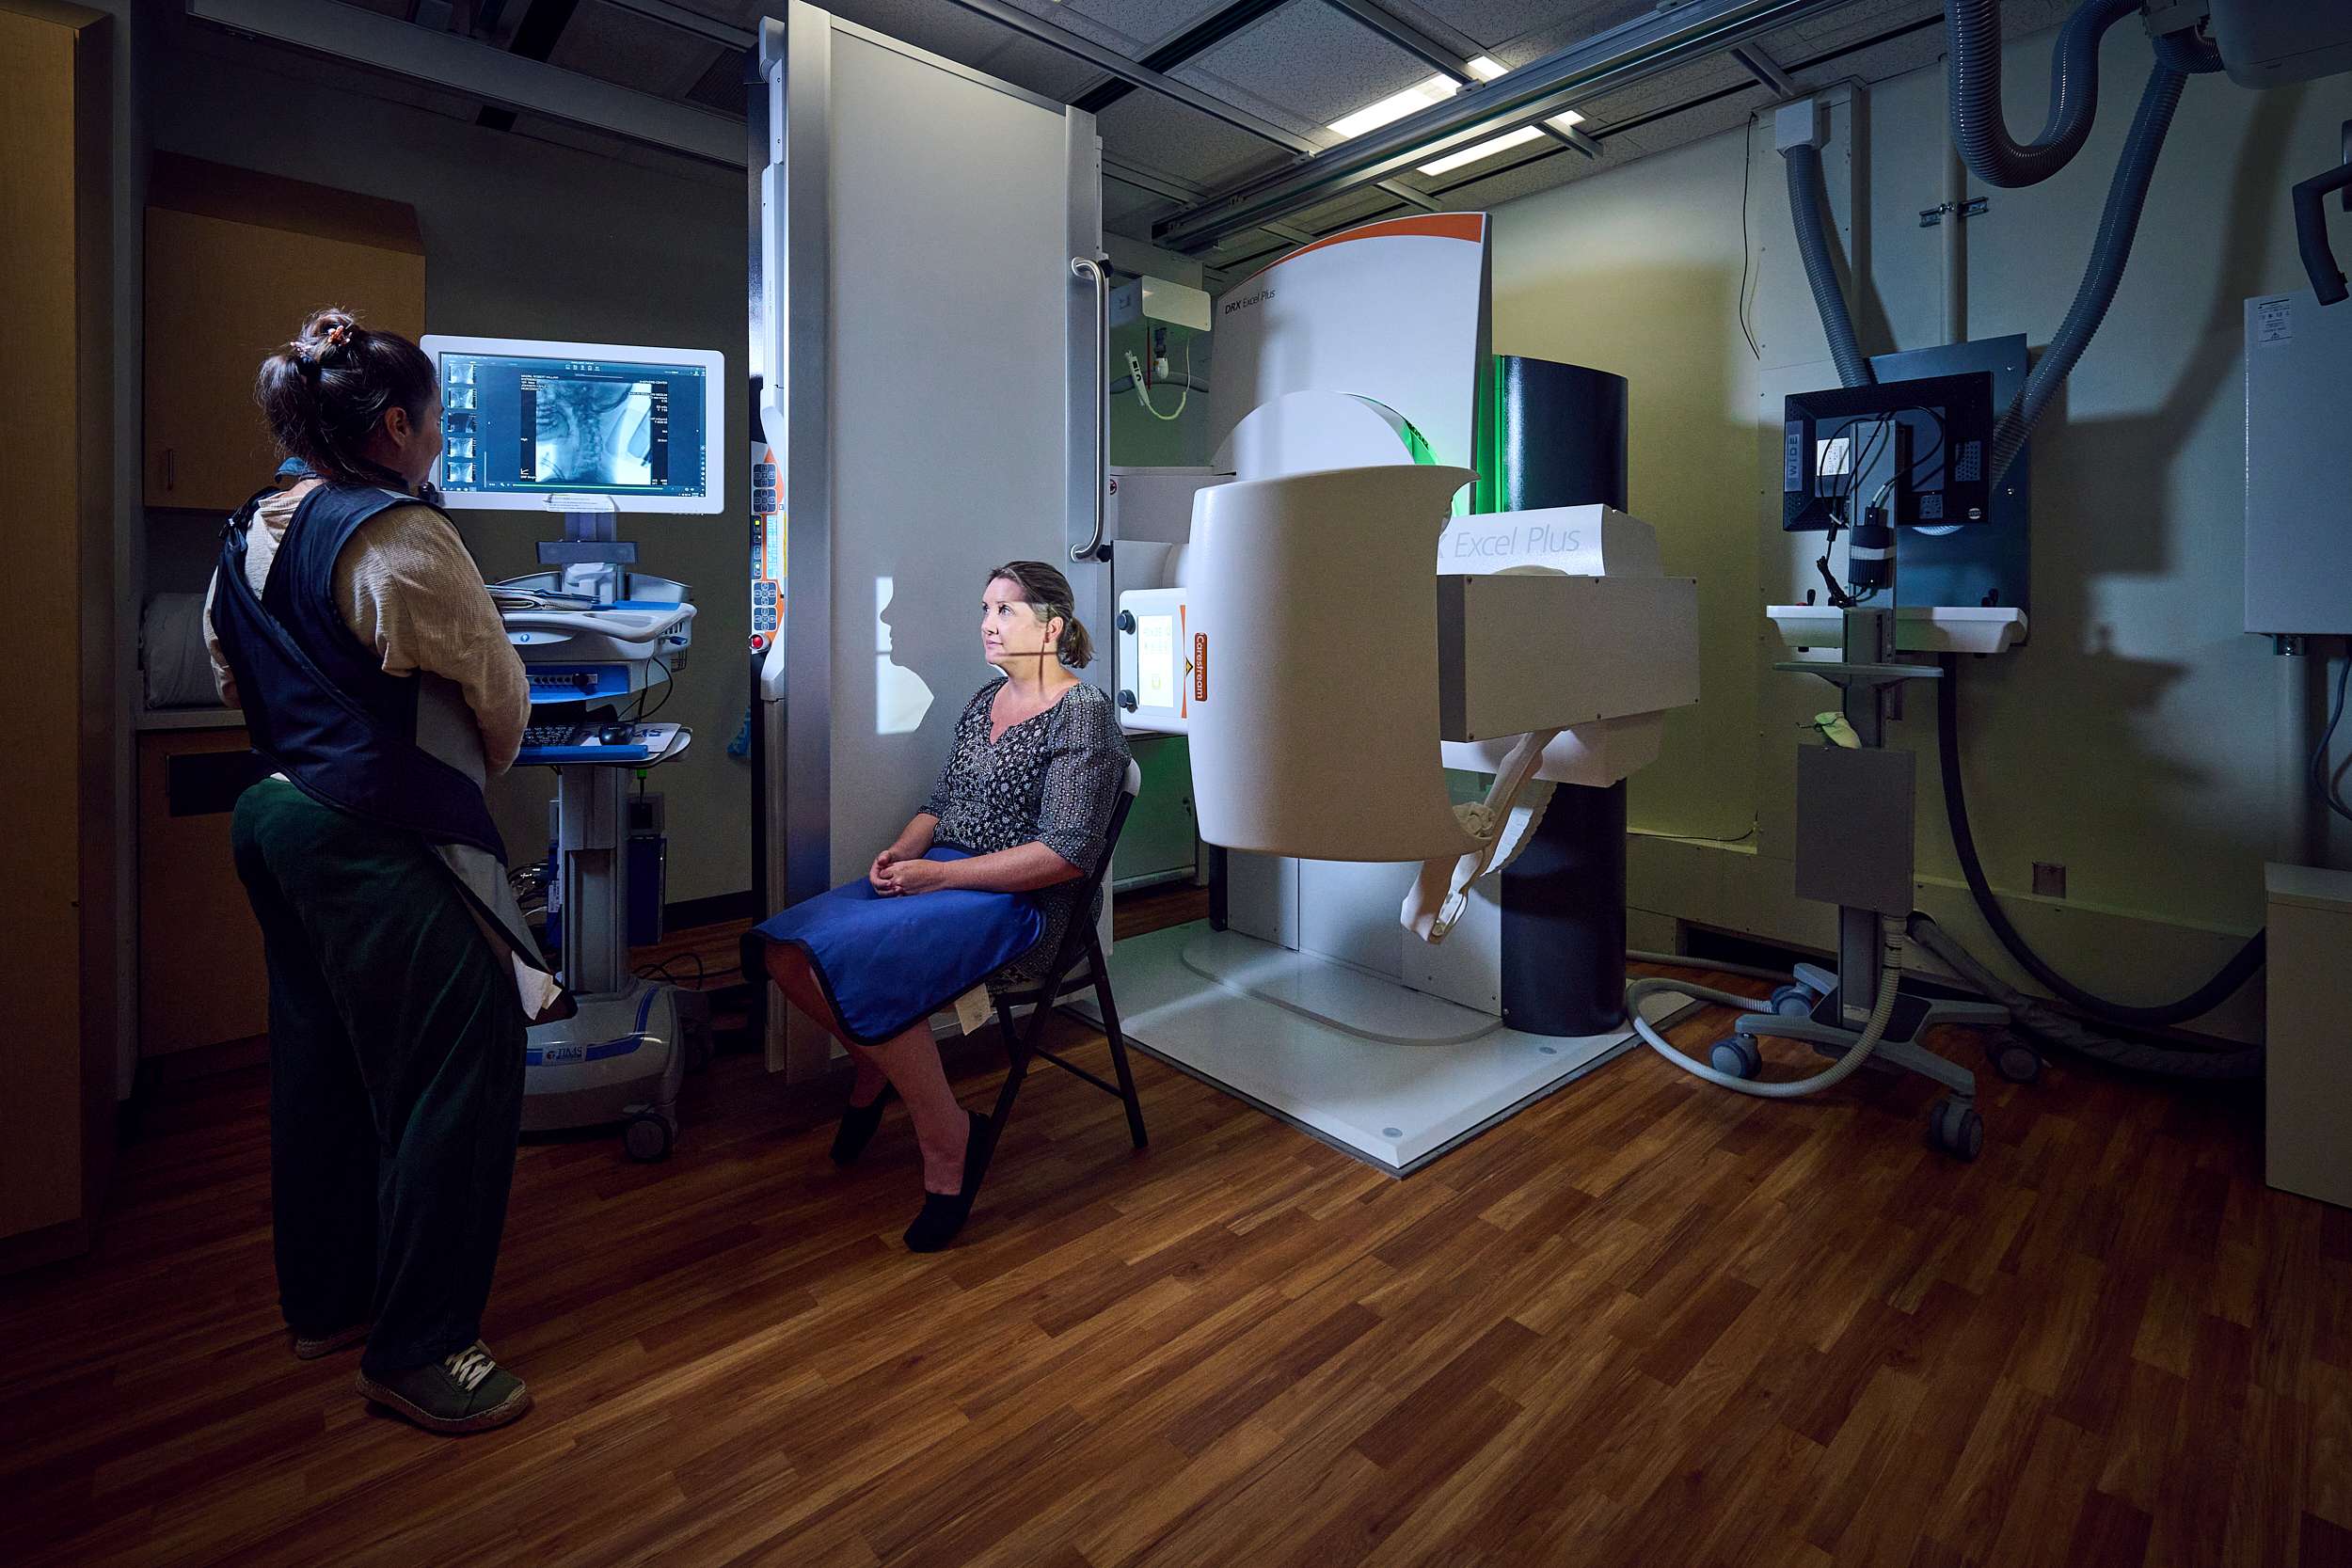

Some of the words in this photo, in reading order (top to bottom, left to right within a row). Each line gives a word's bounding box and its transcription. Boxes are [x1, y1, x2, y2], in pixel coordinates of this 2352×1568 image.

[1225, 300, 1242, 315] DRX
[1243, 293, 1260, 308] Excel
[1261, 289, 1276, 301] Plus
[1789, 436, 1798, 475] WIDE
[1454, 527, 1518, 558] Excel
[1527, 524, 1581, 553] Plus
[1197, 635, 1205, 699] Carestream
